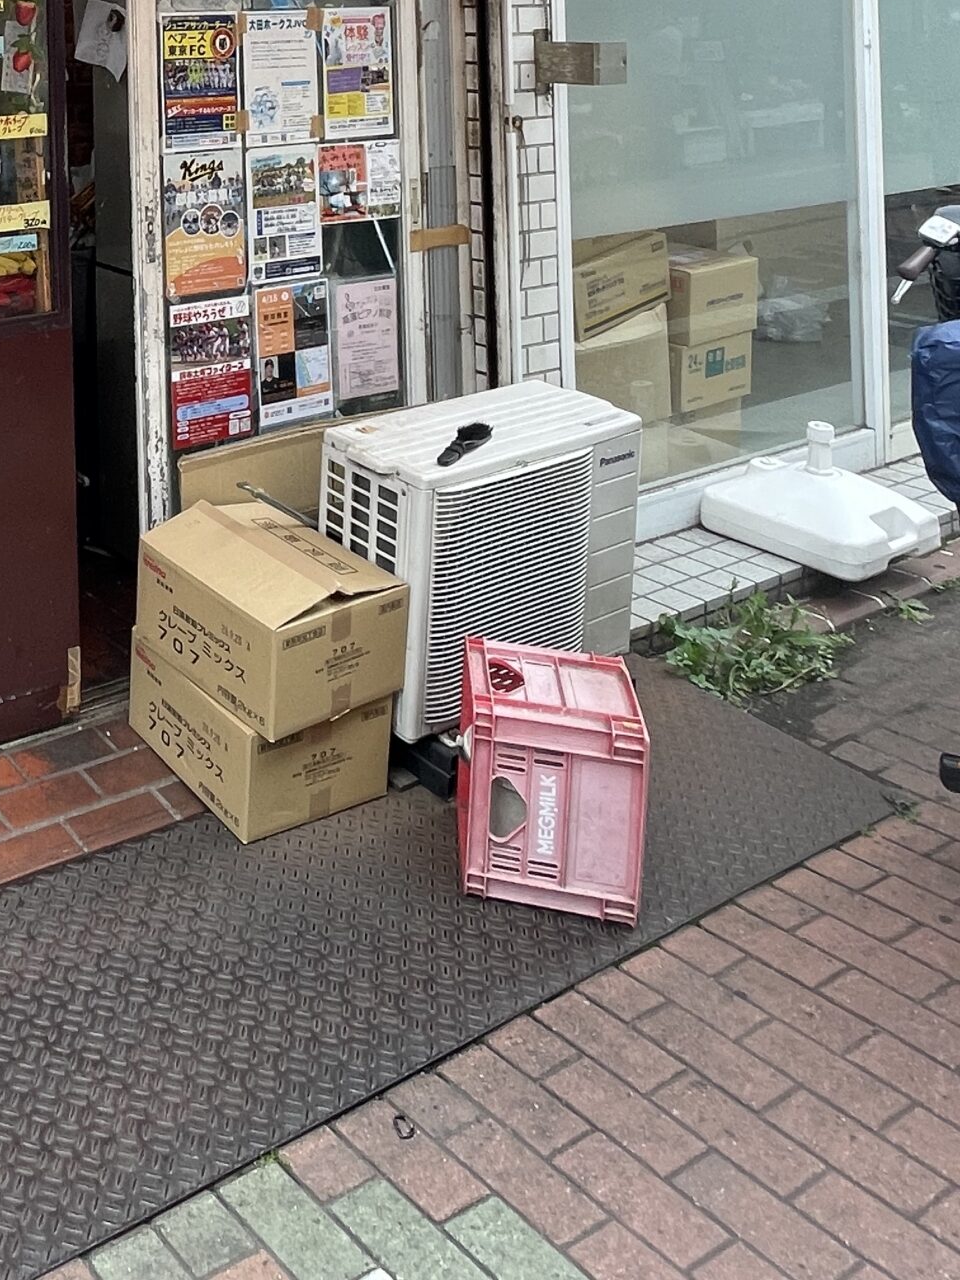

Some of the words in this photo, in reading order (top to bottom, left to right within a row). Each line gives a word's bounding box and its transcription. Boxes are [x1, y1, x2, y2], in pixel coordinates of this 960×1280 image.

[168, 45, 207, 57] 東京FC
[180, 158, 224, 181] Kings
[599, 449, 636, 467] Panasonic
[158, 624, 200, 665] 707
[536, 775, 558, 857] MEGMILK
